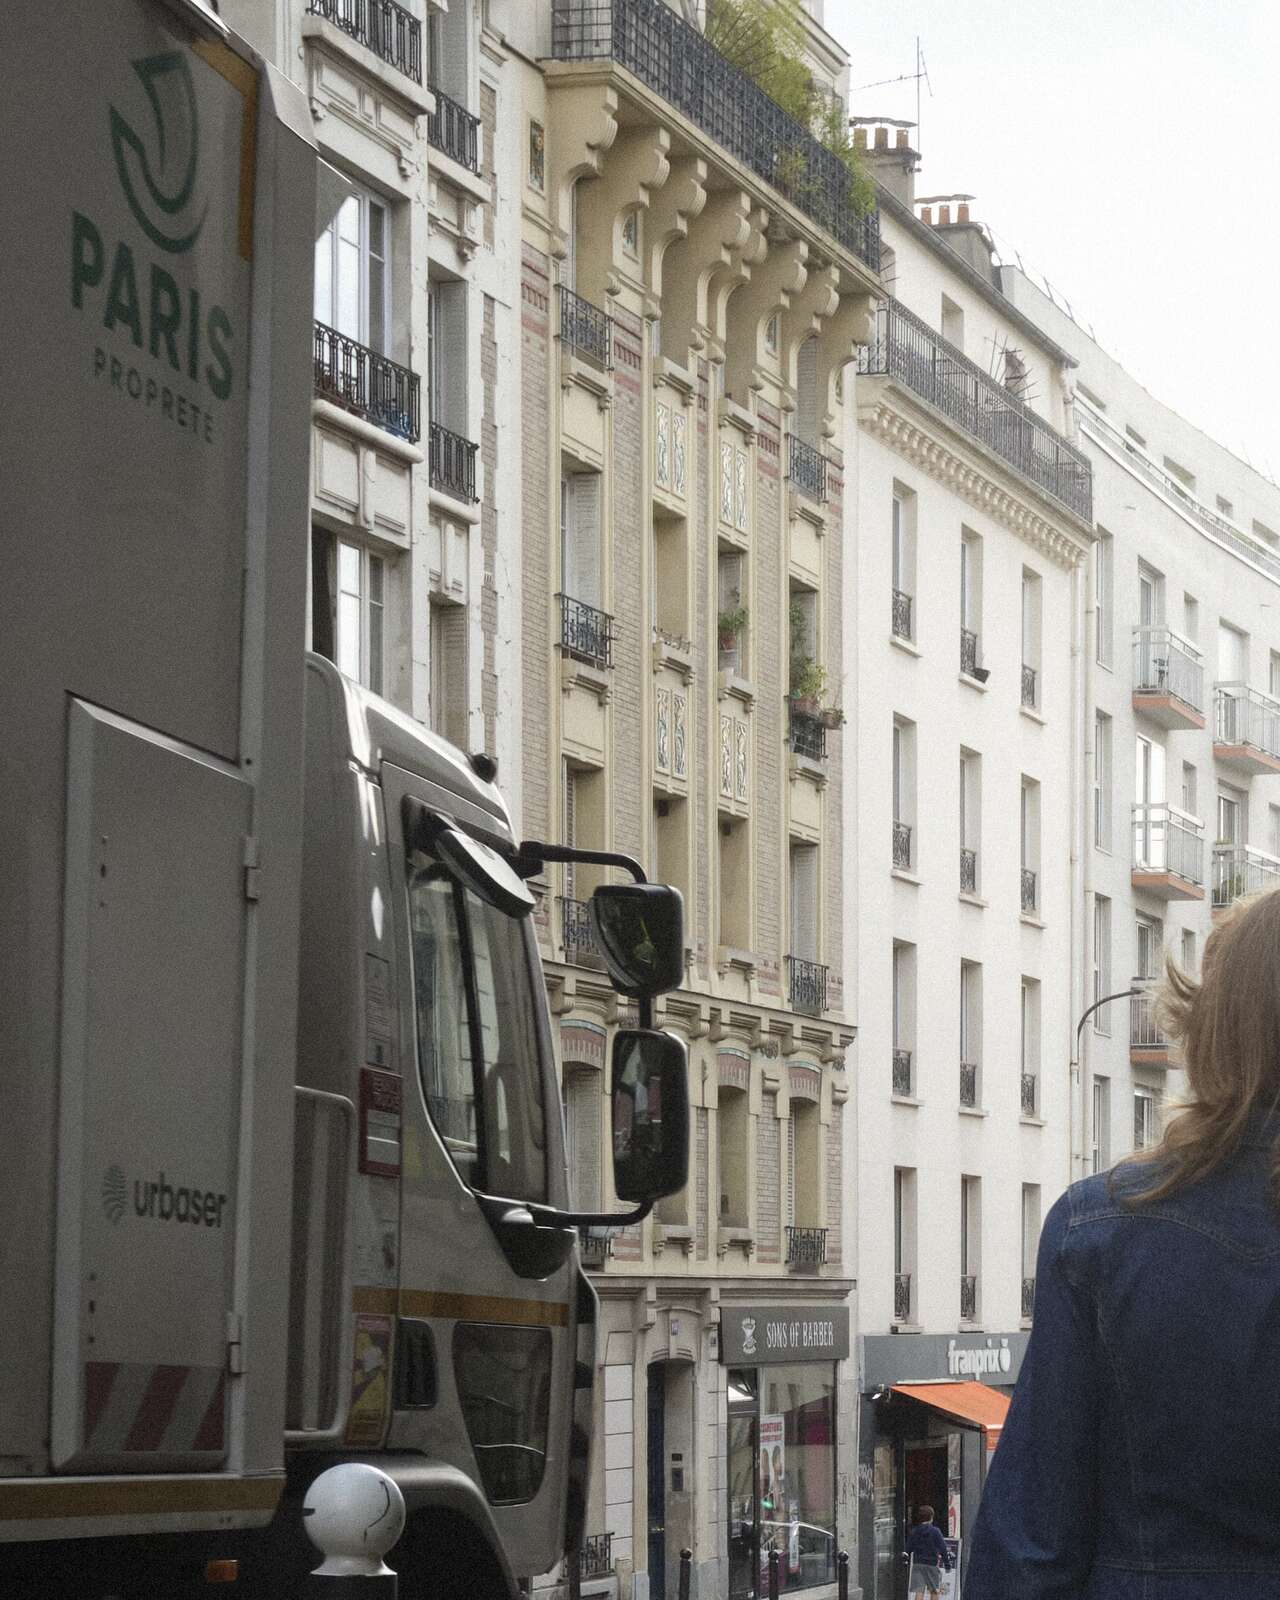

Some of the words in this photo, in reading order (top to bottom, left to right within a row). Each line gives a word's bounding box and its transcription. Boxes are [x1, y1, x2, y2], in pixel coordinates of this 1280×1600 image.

[70, 209, 236, 401] PARIS
[133, 1171, 227, 1228] urbaser
[766, 1322, 788, 1349] SONS
[789, 1321, 800, 1348] OF
[802, 1321, 834, 1347] BARBER
[947, 1338, 1001, 1381] franprix
